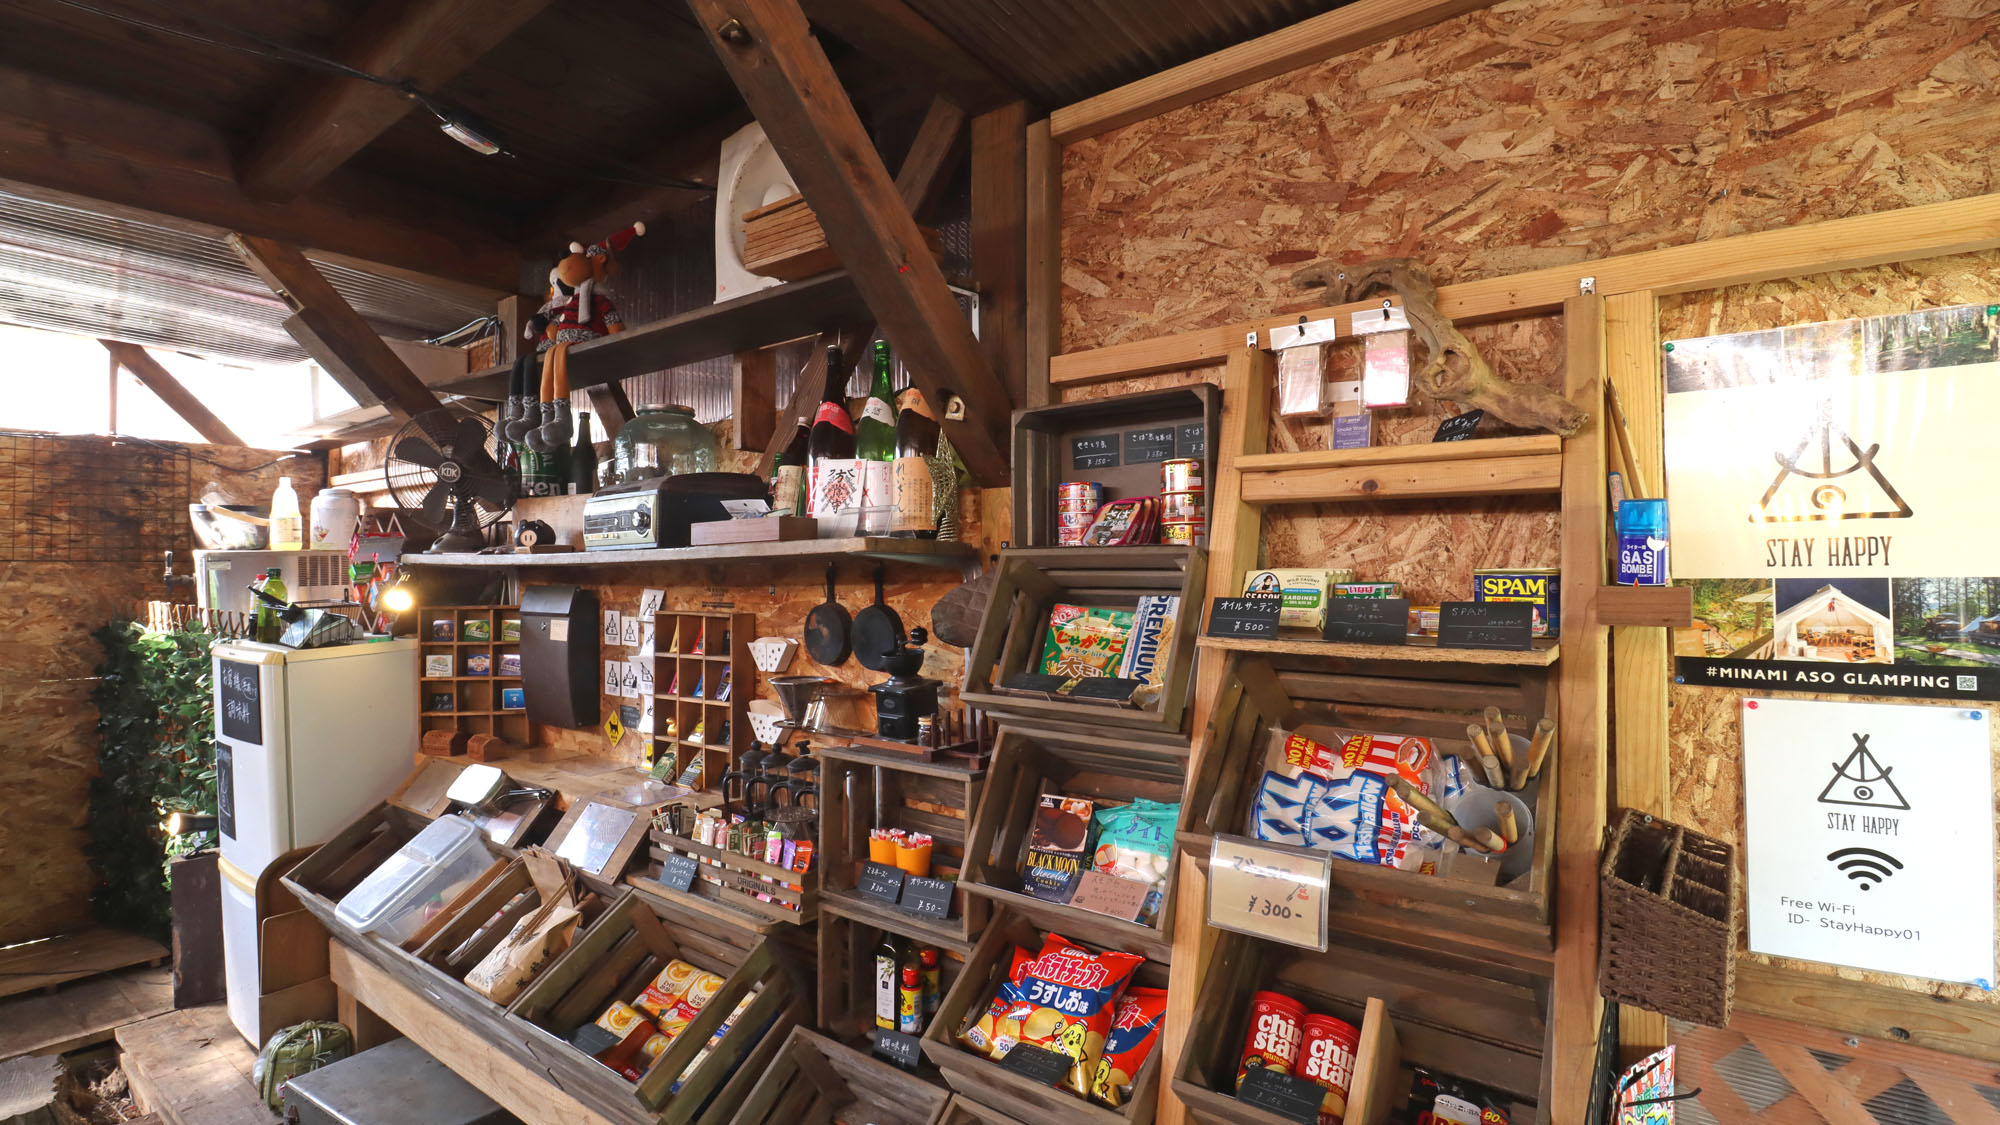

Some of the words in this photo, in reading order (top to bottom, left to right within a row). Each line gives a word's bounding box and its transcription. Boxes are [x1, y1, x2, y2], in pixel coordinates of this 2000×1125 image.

[1621, 550, 1653, 564] GAS
[1766, 538, 1815, 567] STAY
[1827, 536, 1892, 566] HAPPY
[1621, 563, 1653, 574] BOMBE
[1483, 578, 1546, 596] SPAM
[1056, 630, 1125, 653] じゃがりこ
[1706, 666, 1788, 682] #MINAMI
[1795, 670, 1836, 684] ASO
[1843, 671, 1950, 689] GLAMPING
[1349, 735, 1363, 752] FAT
[1827, 812, 1856, 831] STAY
[1862, 815, 1900, 836] HAPPY
[1026, 851, 1055, 870] BLACK
[1055, 856, 1080, 874] MOON
[737, 876, 777, 896] ORIGINALS
[1780, 896, 1814, 911] Free
[1817, 901, 1856, 916] Wi-Fi
[1787, 913, 1811, 925] ID-
[1819, 917, 1922, 941] StayHappy01
[1031, 952, 1110, 992] ポテトチップス
[1029, 981, 1090, 1014] うすしお味
